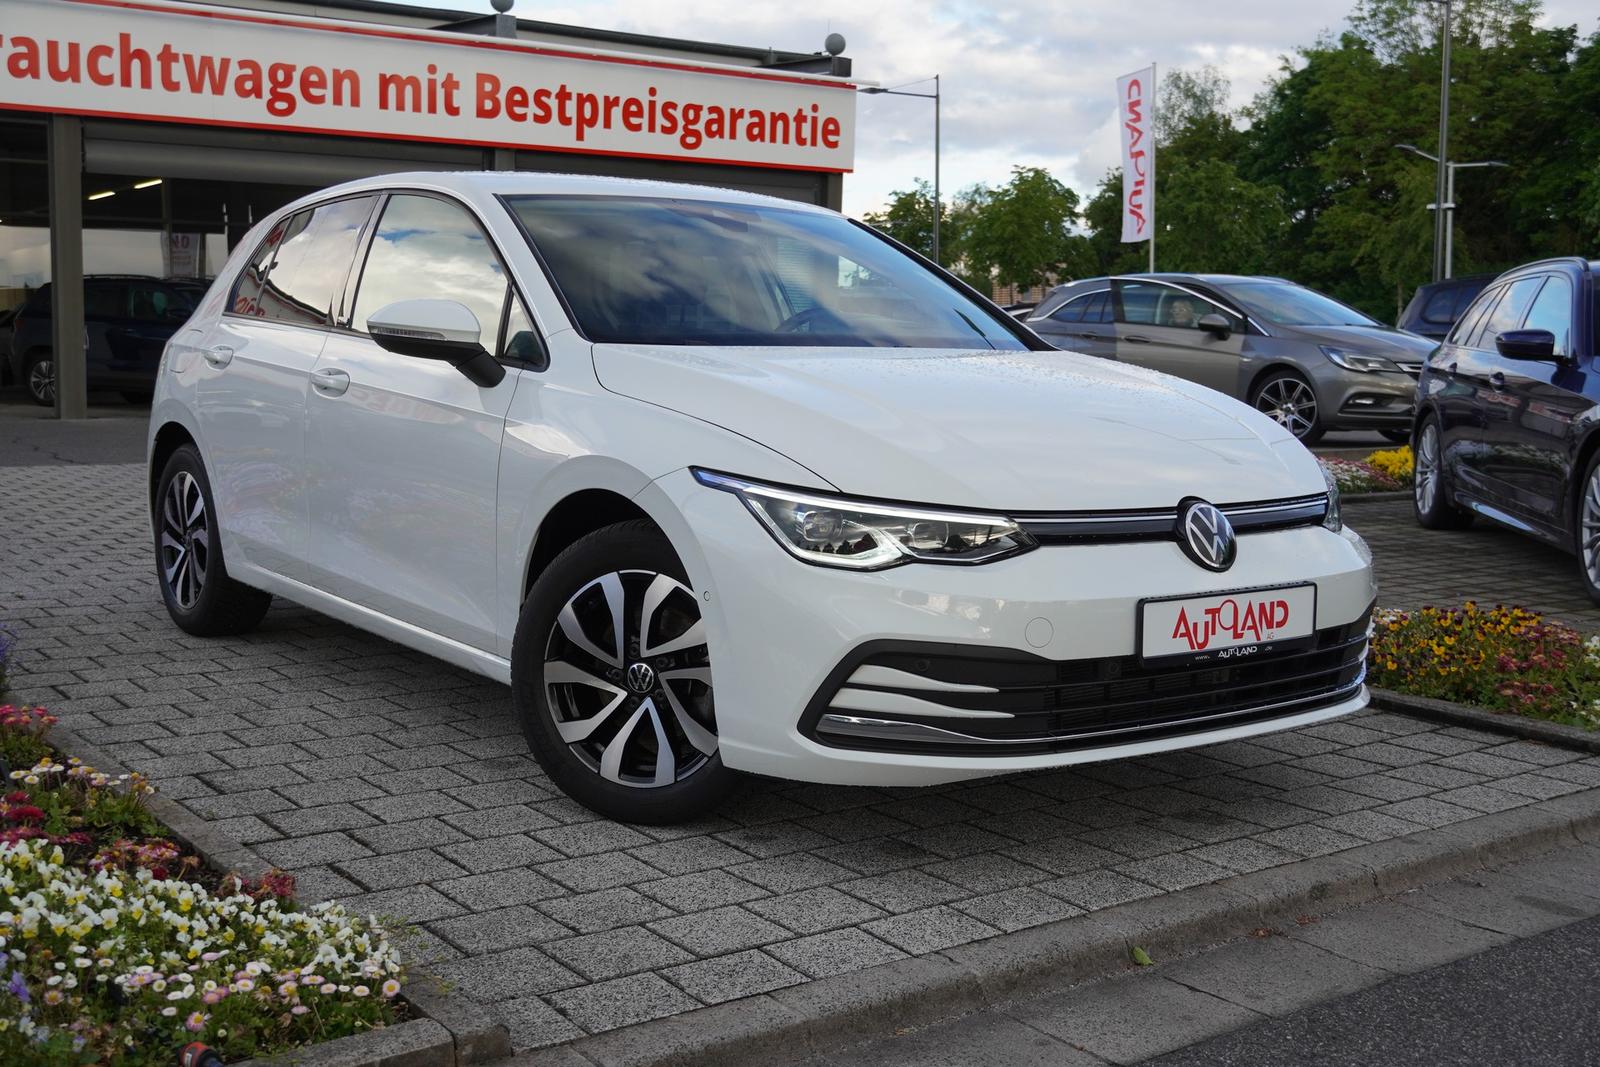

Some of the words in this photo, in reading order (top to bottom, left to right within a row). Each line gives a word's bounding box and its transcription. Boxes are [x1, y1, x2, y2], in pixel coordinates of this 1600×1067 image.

[0, 32, 361, 117] auchtwagen
[378, 63, 461, 116] mit
[475, 72, 842, 150] Bestpreisgarantie
[1172, 599, 1289, 651] AUTOLAND
[1218, 646, 1257, 658] AUTOLAND
